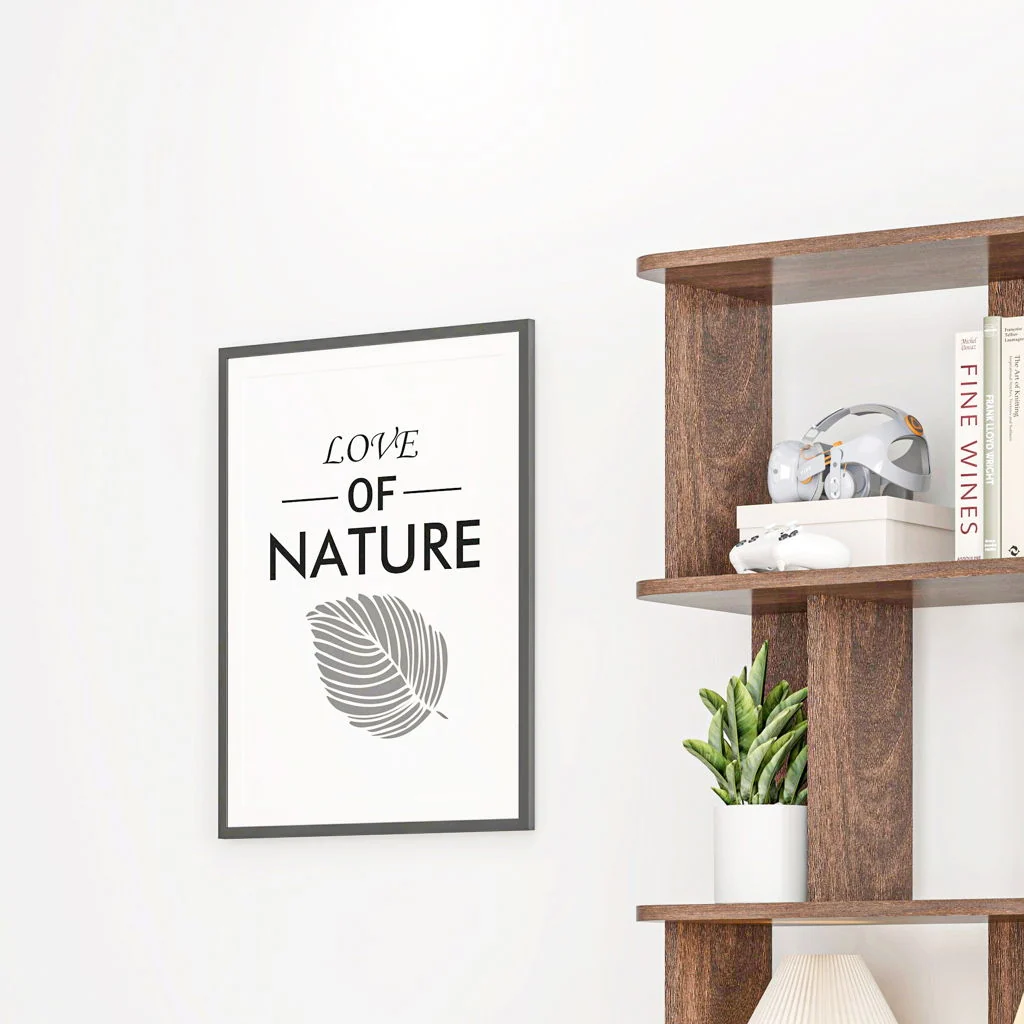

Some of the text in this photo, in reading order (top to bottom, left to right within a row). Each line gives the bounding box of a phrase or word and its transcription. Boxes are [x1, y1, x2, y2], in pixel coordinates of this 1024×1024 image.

[960, 365, 978, 426] FINE
[322, 426, 419, 464] LOVE
[985, 394, 994, 485] FRANK LLOYD WRIGHT
[347, 475, 397, 513] OF
[960, 440, 978, 534] WINES
[269, 519, 480, 581] NATURE
